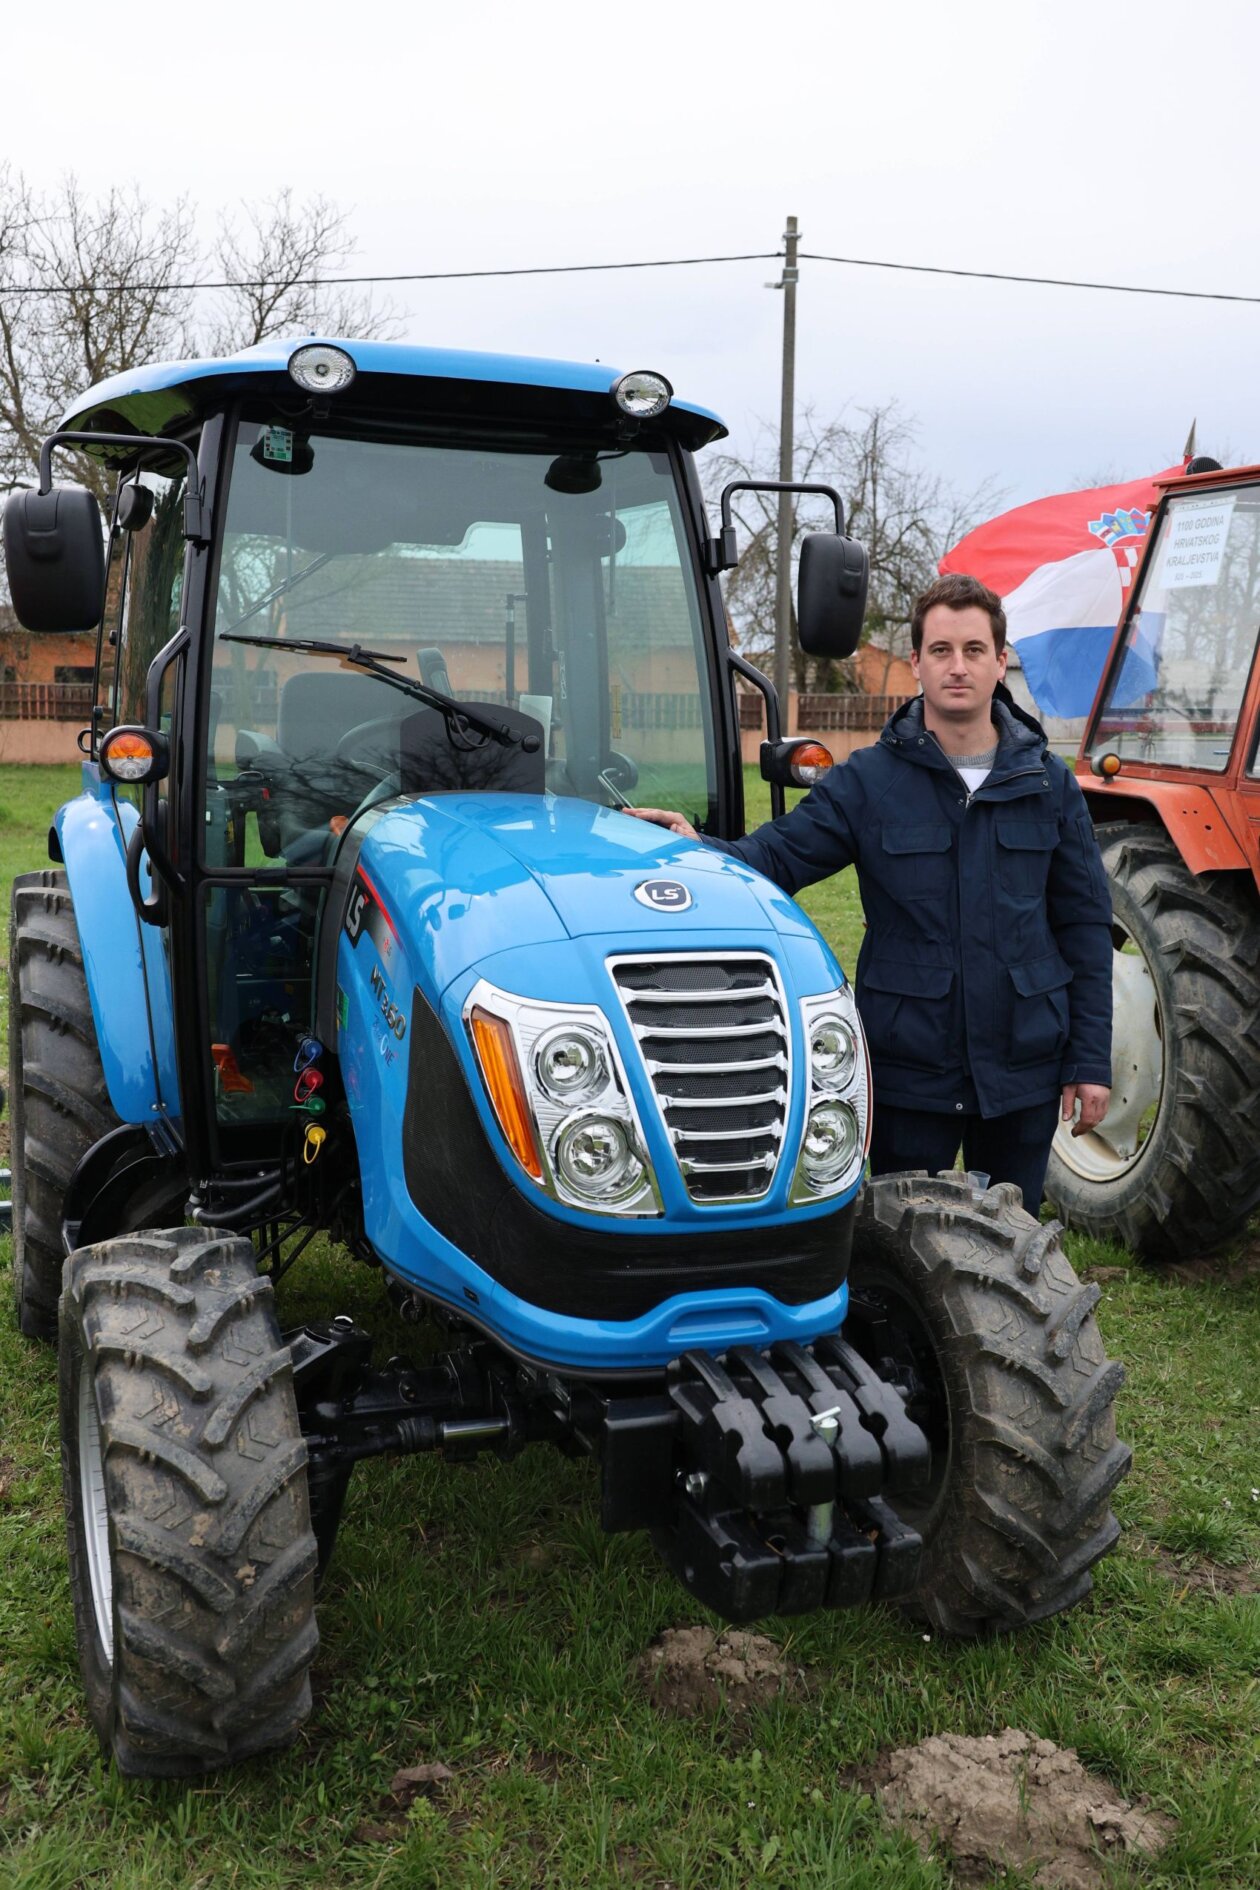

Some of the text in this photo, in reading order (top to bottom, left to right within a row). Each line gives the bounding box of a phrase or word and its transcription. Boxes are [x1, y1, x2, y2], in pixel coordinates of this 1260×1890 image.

[1178, 516, 1224, 532] 1100 GODINA
[1174, 534, 1220, 549] HRVATSKOG
[1166, 552, 1219, 568] KRALJEVSTVA
[651, 888, 680, 900] LS
[346, 885, 364, 937] LS
